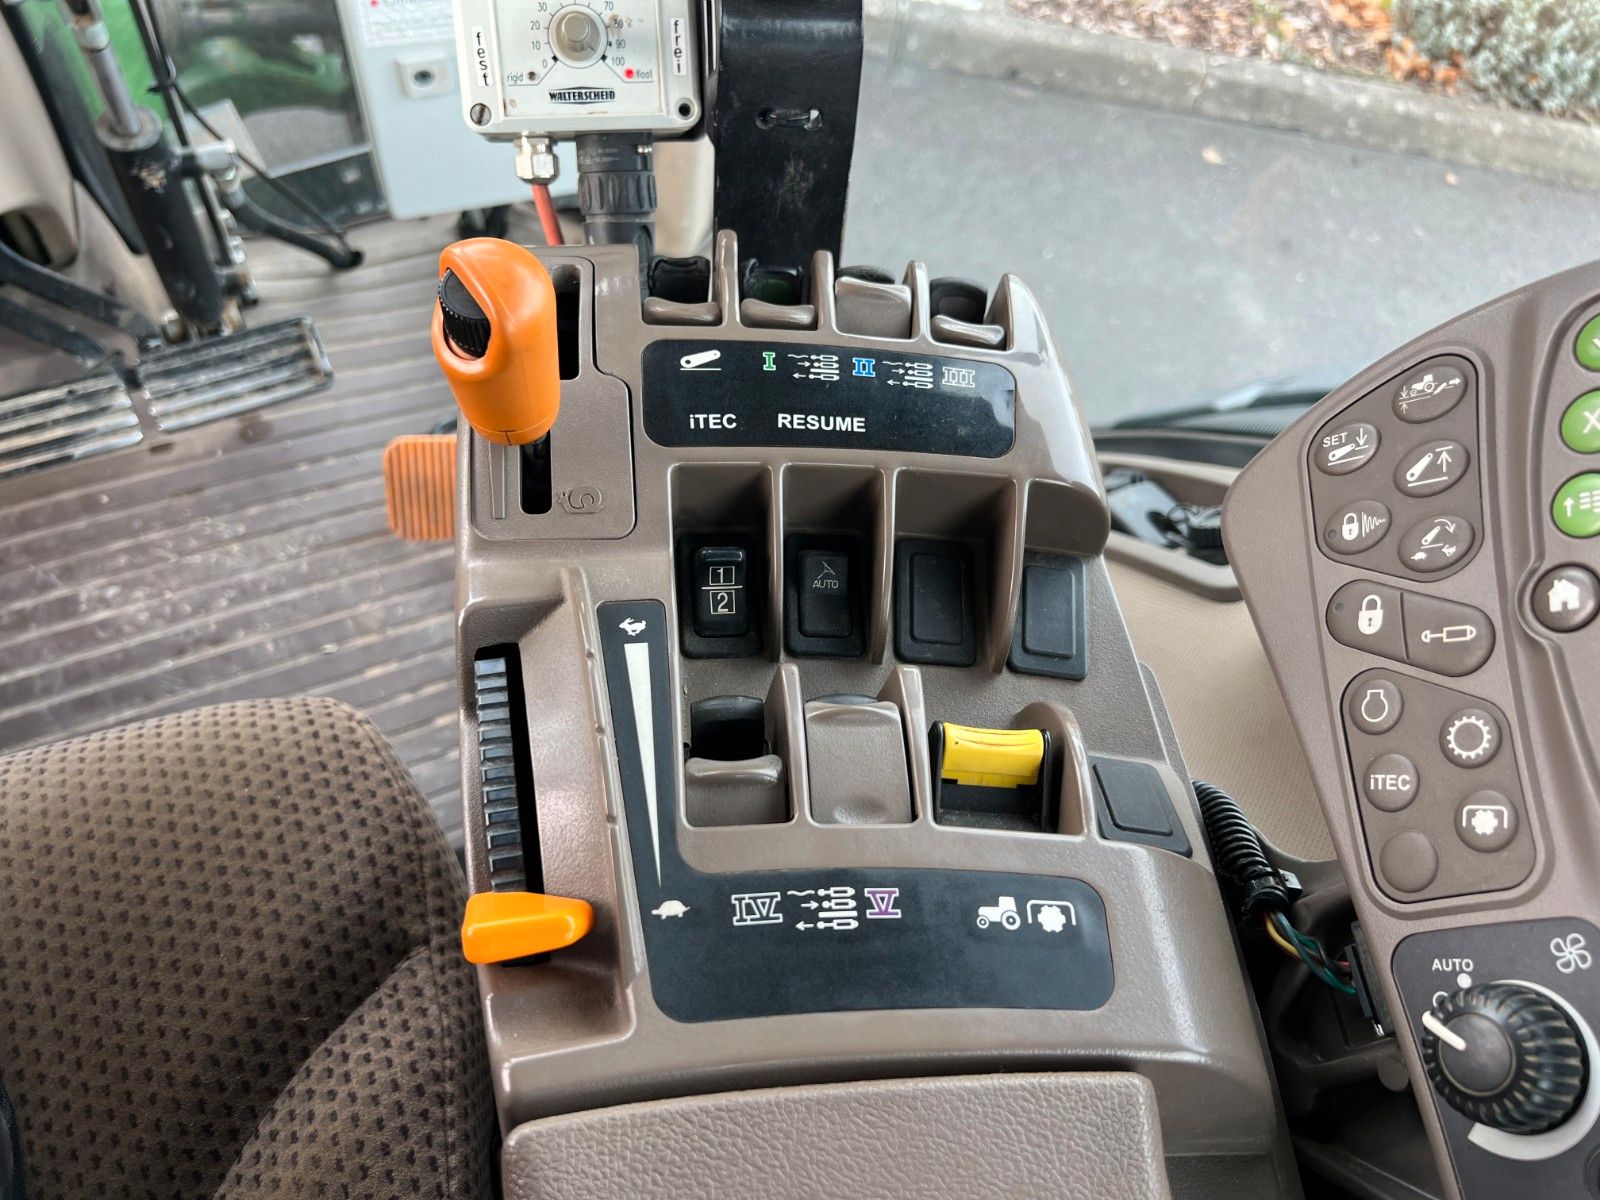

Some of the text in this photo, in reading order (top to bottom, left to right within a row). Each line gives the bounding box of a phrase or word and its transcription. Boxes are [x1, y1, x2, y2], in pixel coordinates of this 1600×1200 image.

[537, 2, 548, 12] 30
[604, 1, 614, 11] 70
[530, 20, 541, 31] 20
[531, 41, 541, 51] 10
[673, 19, 682, 74] frei
[475, 32, 488, 87] fest
[611, 56, 625, 67] 100
[507, 72, 524, 84] rigid
[549, 90, 616, 101] WALTERSCHEID
[688, 413, 738, 430] iTEC
[777, 413, 867, 433] RESUME
[1322, 432, 1348, 448] SET
[812, 579, 839, 590] AUTO
[717, 593, 729, 613] 2
[1369, 774, 1411, 792] iTEC
[1431, 958, 1474, 973] AUTO
